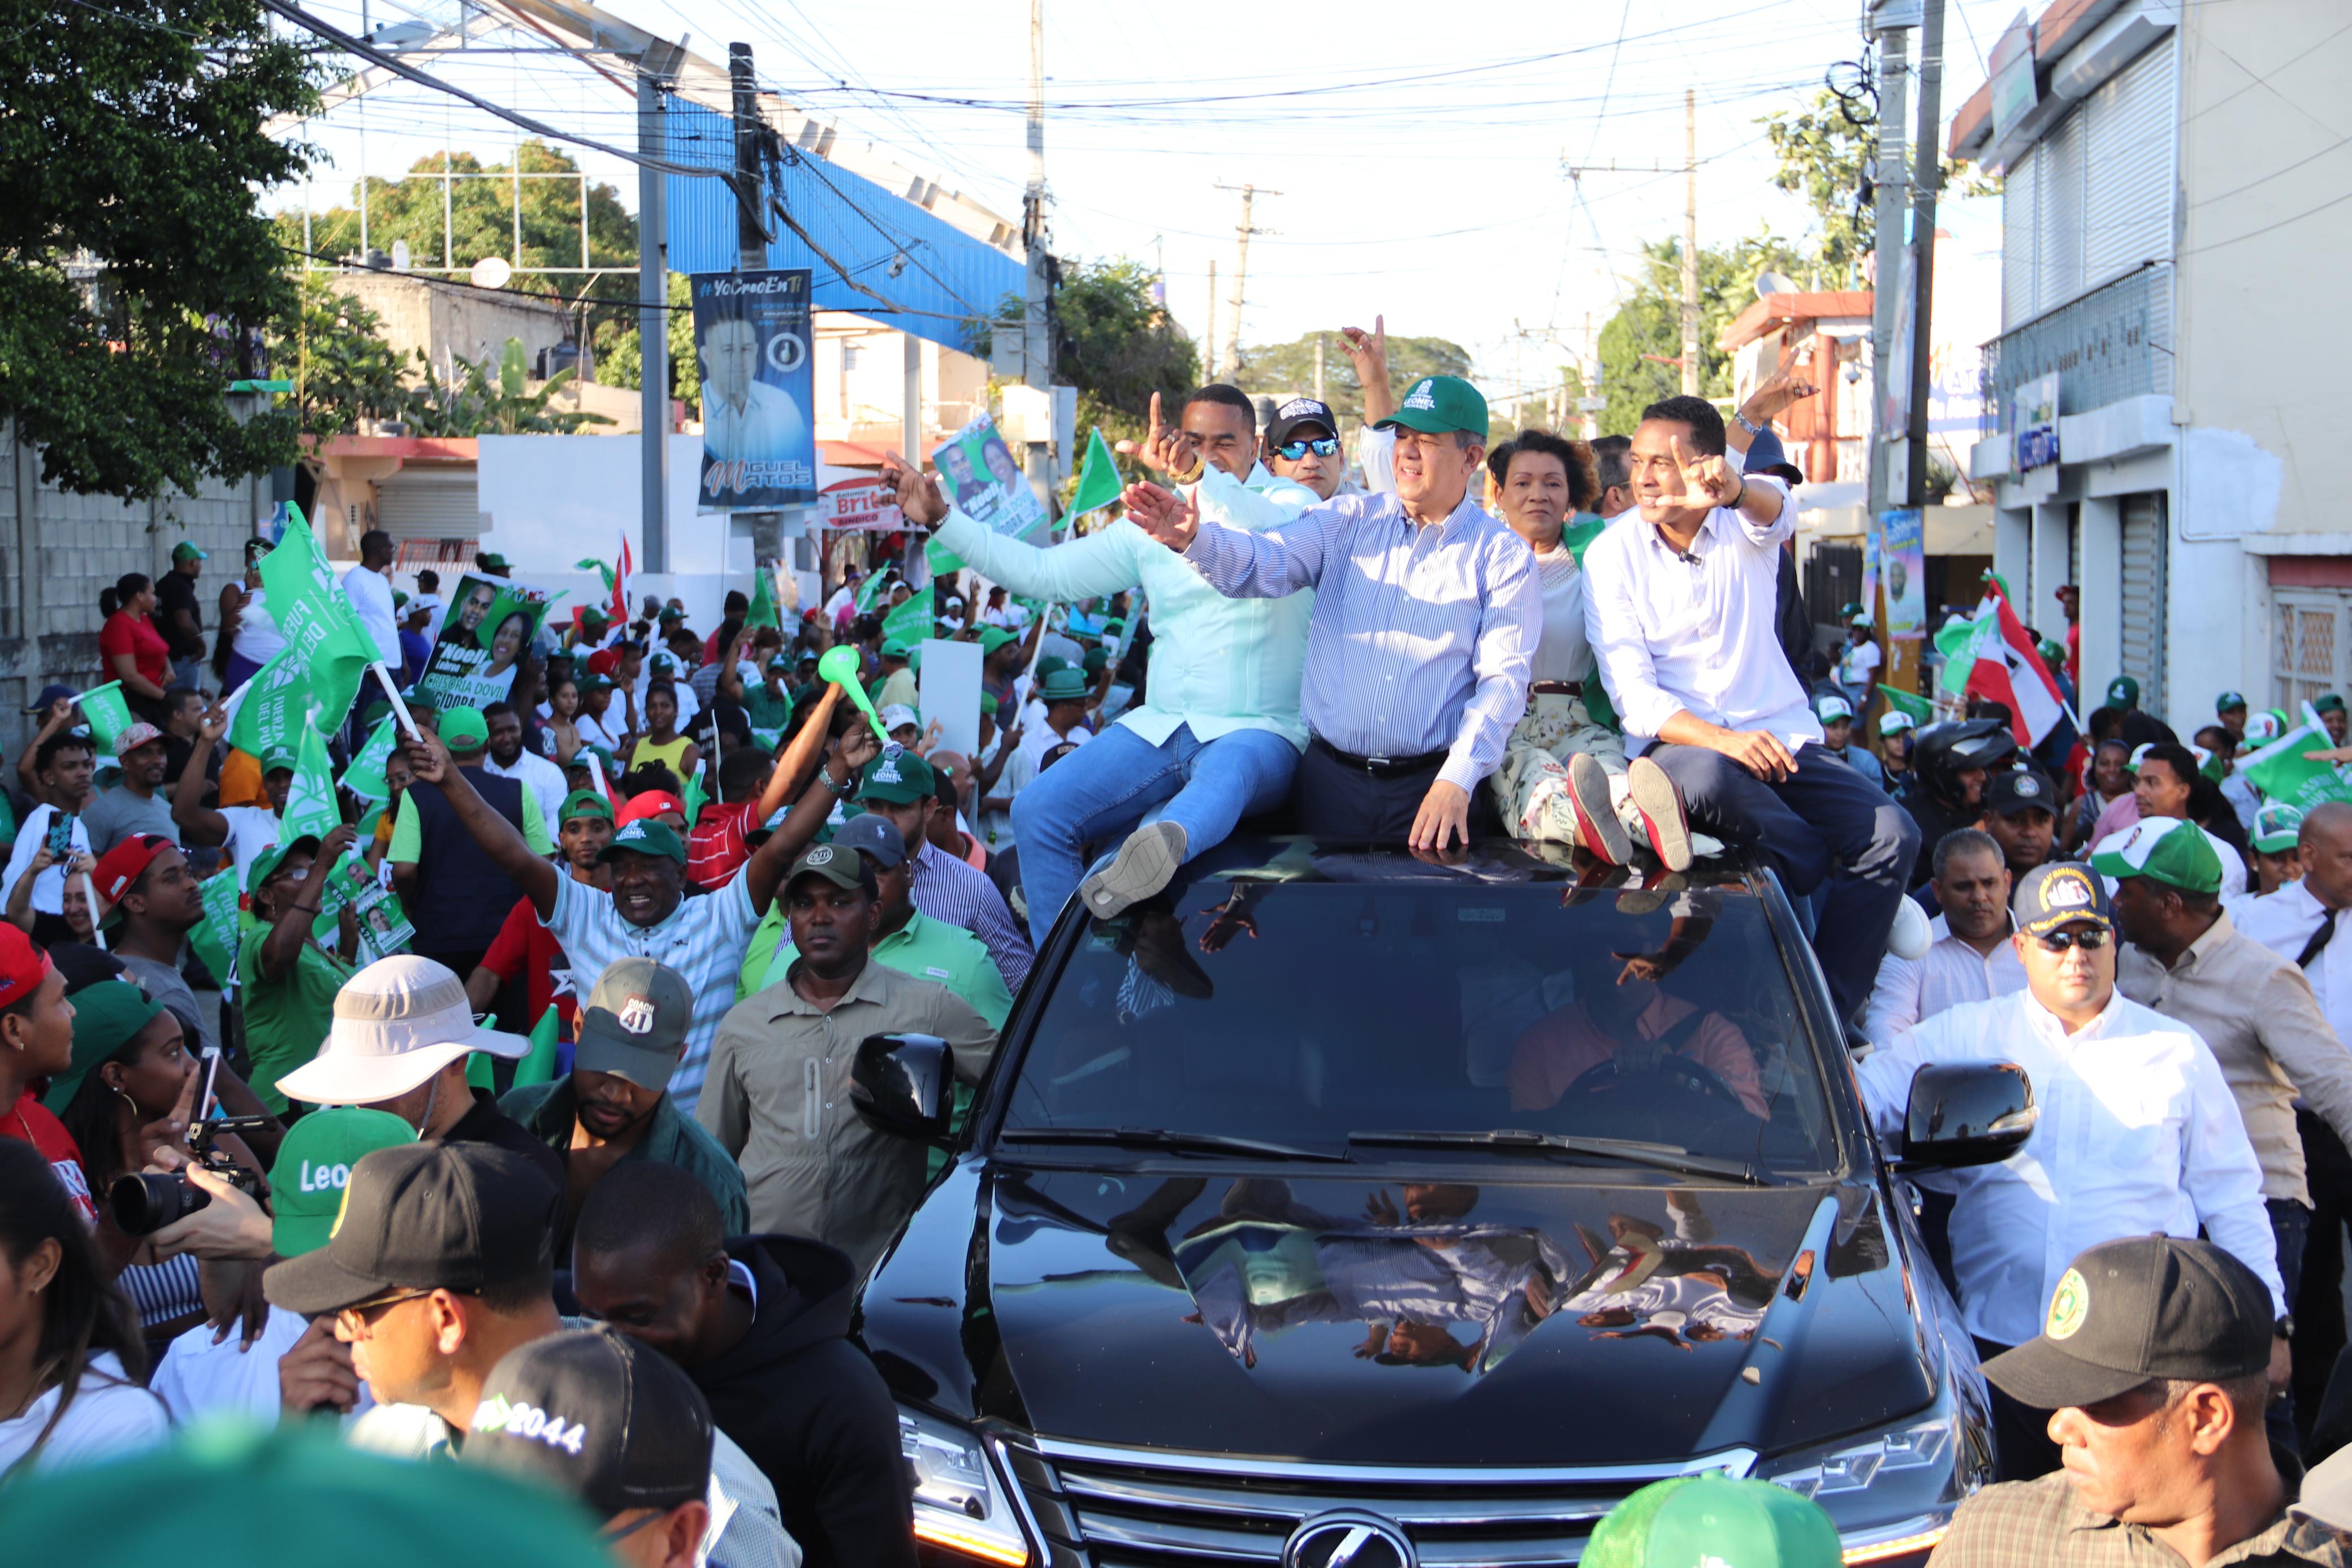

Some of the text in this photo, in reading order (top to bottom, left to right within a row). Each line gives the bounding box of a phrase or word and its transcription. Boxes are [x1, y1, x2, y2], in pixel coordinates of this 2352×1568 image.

[699, 275, 803, 298] #YoCreoEnTi
[1403, 397, 1436, 409] LEONEL
[837, 490, 867, 499] Antonio
[837, 491, 882, 514] Brit
[474, 682, 505, 699] DOVIL
[258, 701, 271, 725] DEL
[272, 696, 285, 742] FUERZA
[872, 772, 903, 782] LEONEL
[205, 900, 222, 925] DEL
[628, 998, 655, 1013] COACH
[624, 1011, 647, 1030] 41
[505, 1401, 586, 1455] 2044
